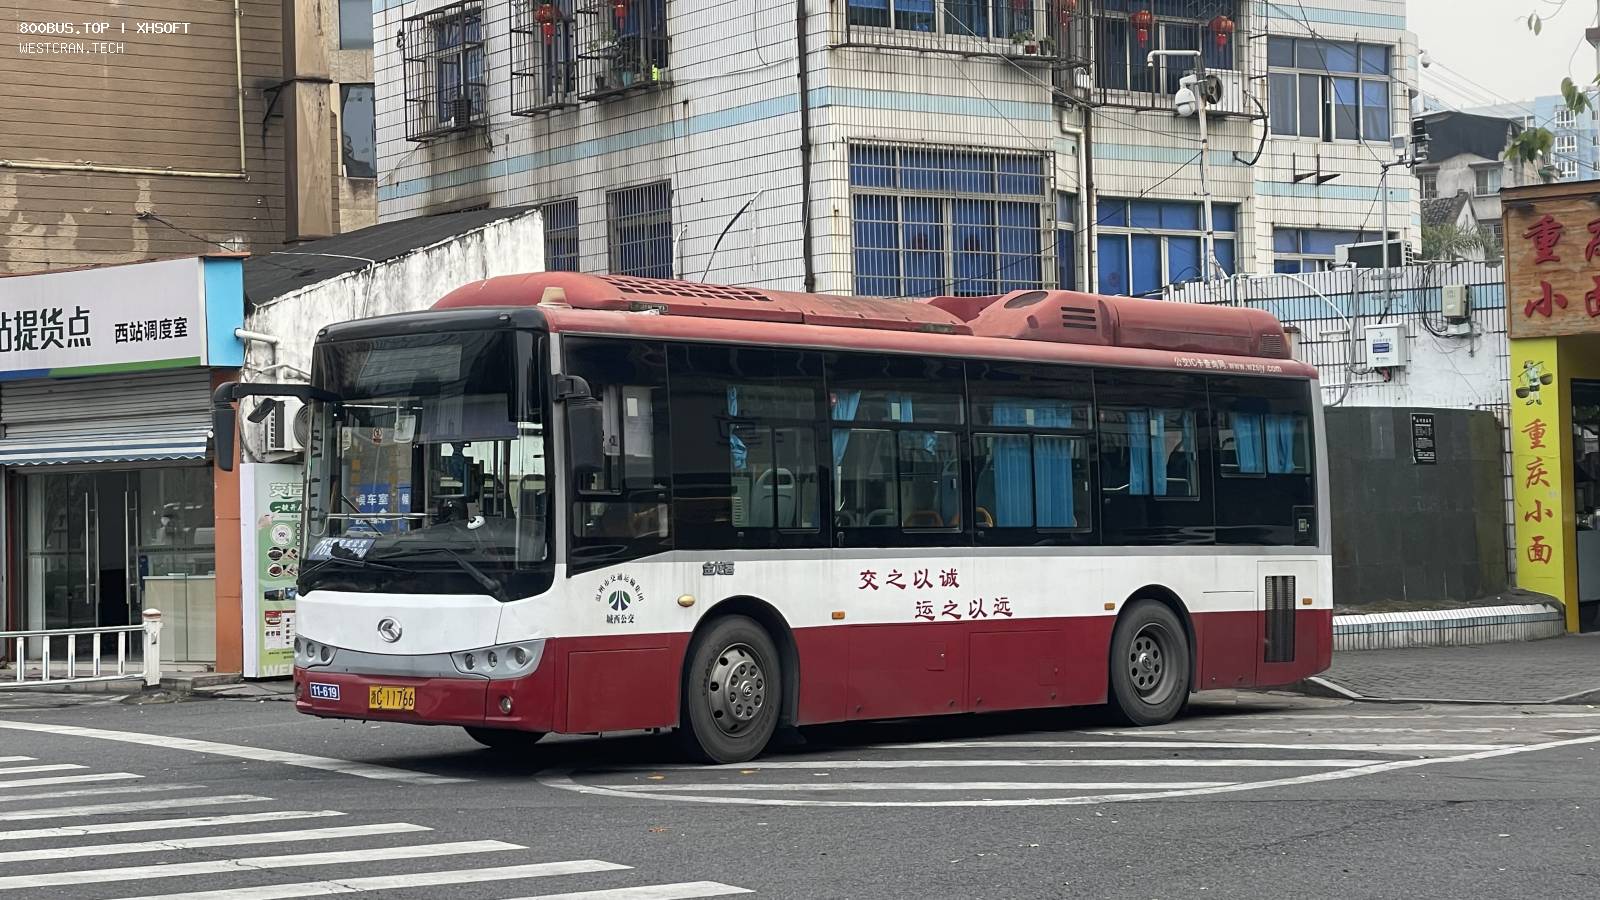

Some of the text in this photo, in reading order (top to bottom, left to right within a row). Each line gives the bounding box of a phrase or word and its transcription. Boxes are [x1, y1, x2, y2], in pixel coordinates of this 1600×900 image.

[115, 317, 189, 344] 西站调度室
[1521, 418, 1553, 565] 重庆小面
[858, 568, 960, 591] 交之以诚
[914, 597, 1013, 621] 运之以远
[311, 685, 338, 698] 11-619
